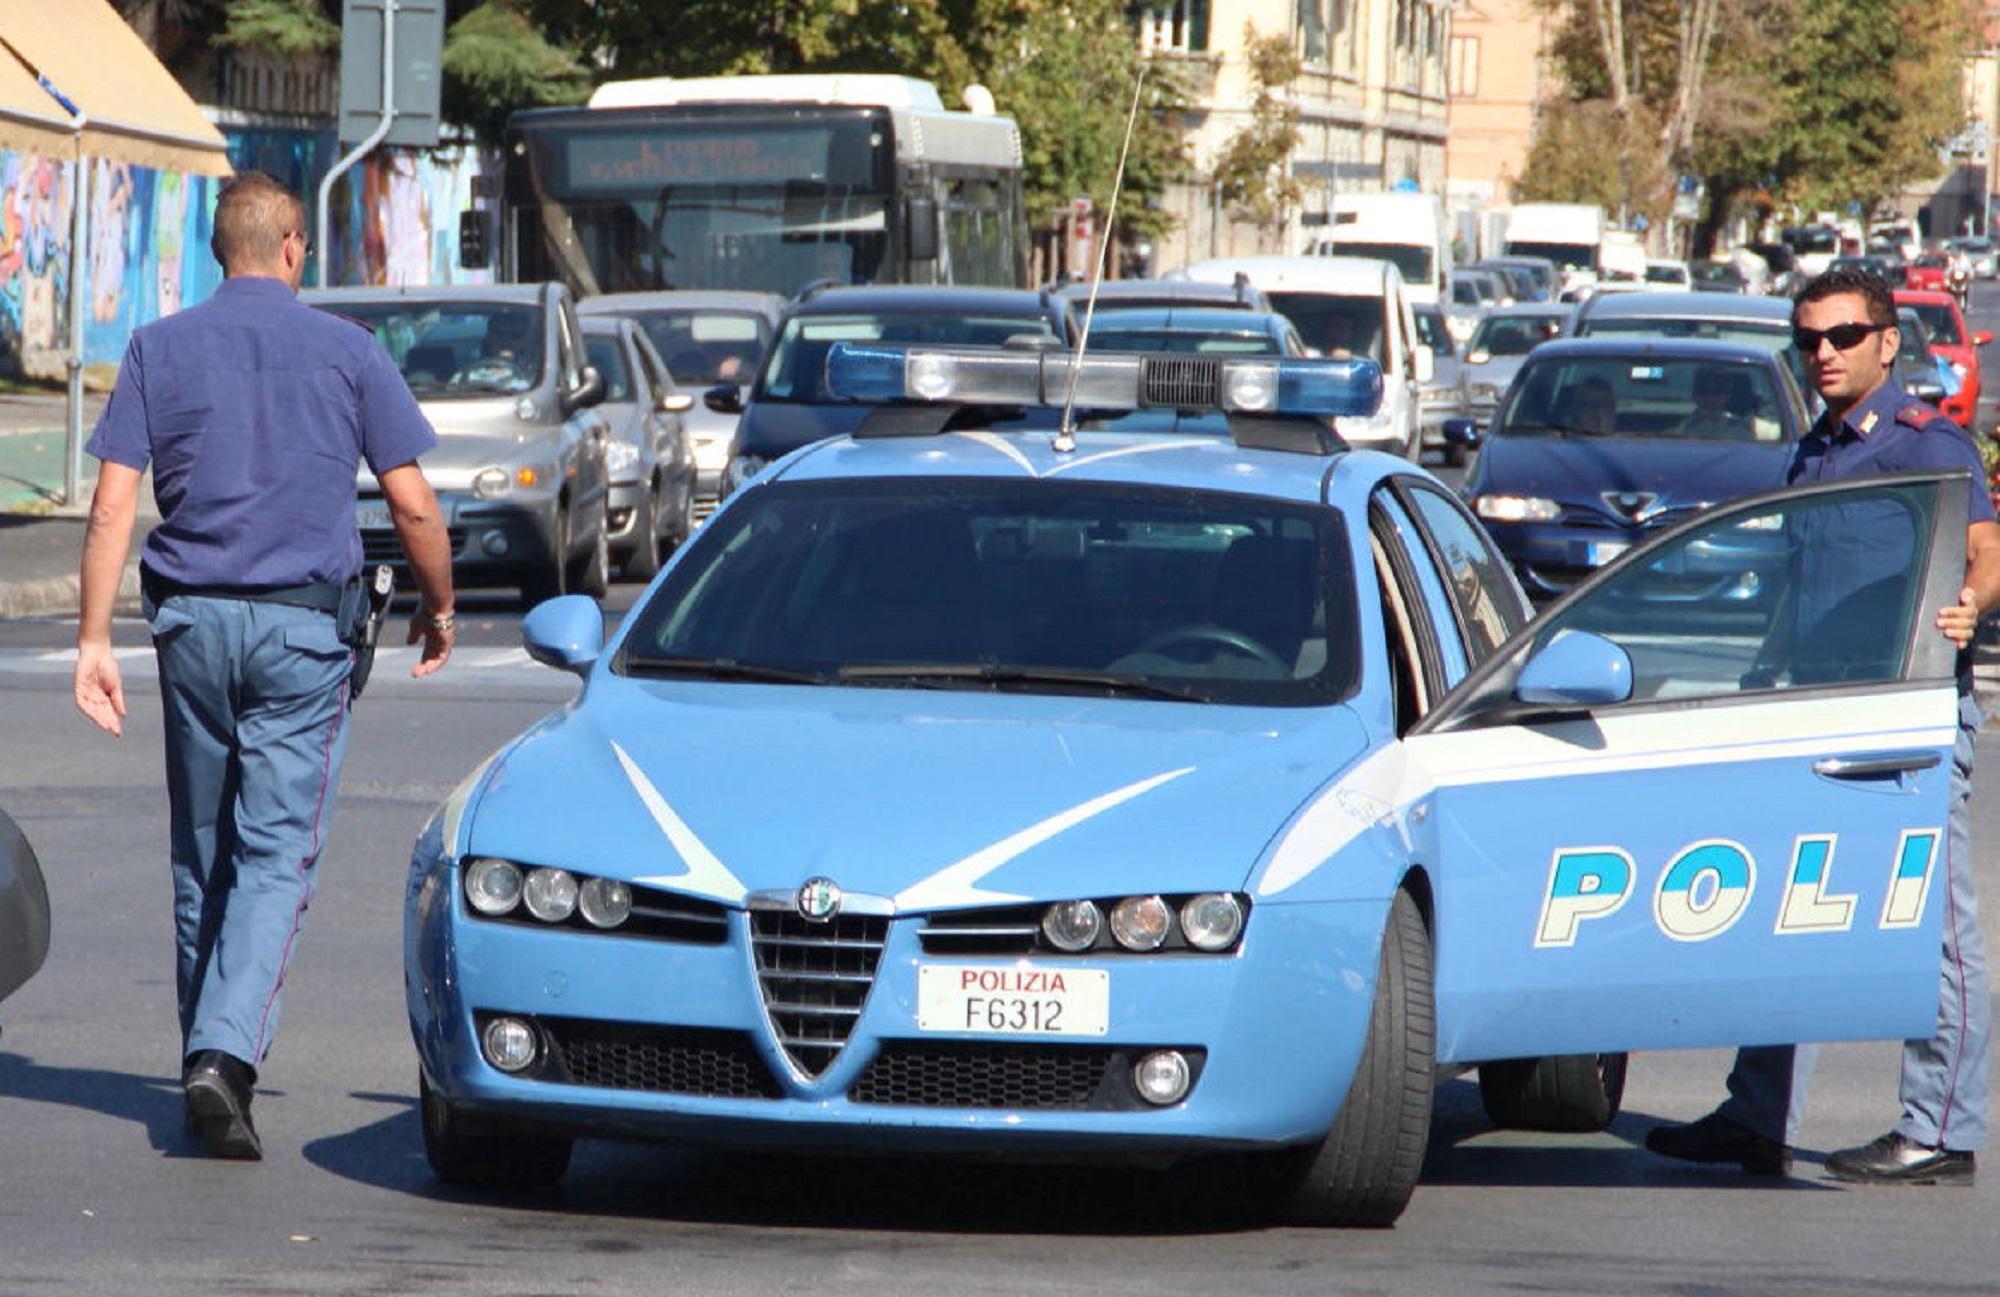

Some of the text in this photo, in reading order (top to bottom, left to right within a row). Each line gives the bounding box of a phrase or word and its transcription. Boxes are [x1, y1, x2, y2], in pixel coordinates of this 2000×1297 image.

[1533, 827, 1943, 948] POLI
[960, 970, 1067, 993] POLIZIA
[965, 997, 1063, 1031] F6312
